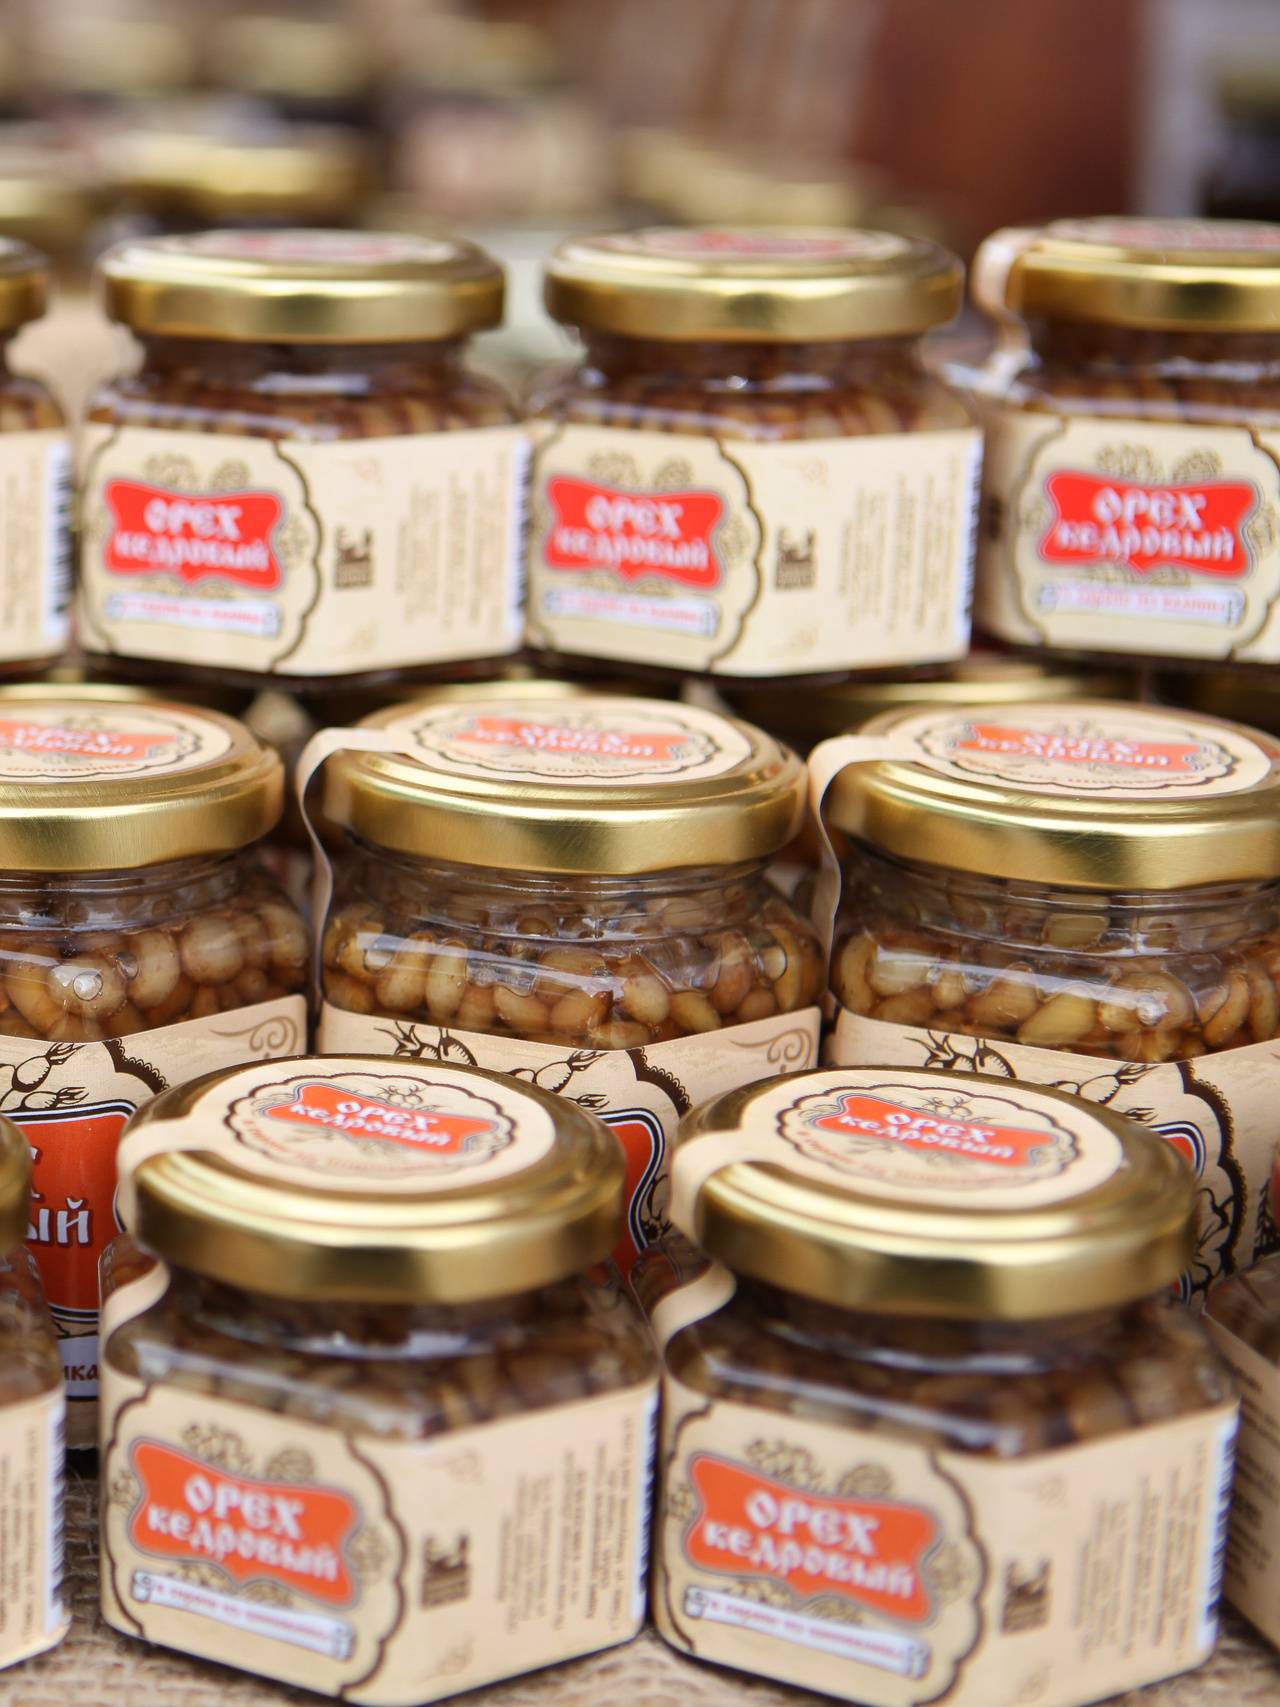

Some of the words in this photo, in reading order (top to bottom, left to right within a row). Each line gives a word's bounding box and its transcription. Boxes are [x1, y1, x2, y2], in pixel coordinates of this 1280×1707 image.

[1093, 487, 1207, 530] ОРЕХ
[184, 1474, 306, 1541] ОРЕХ
[745, 1491, 880, 1557] ОРЕХ
